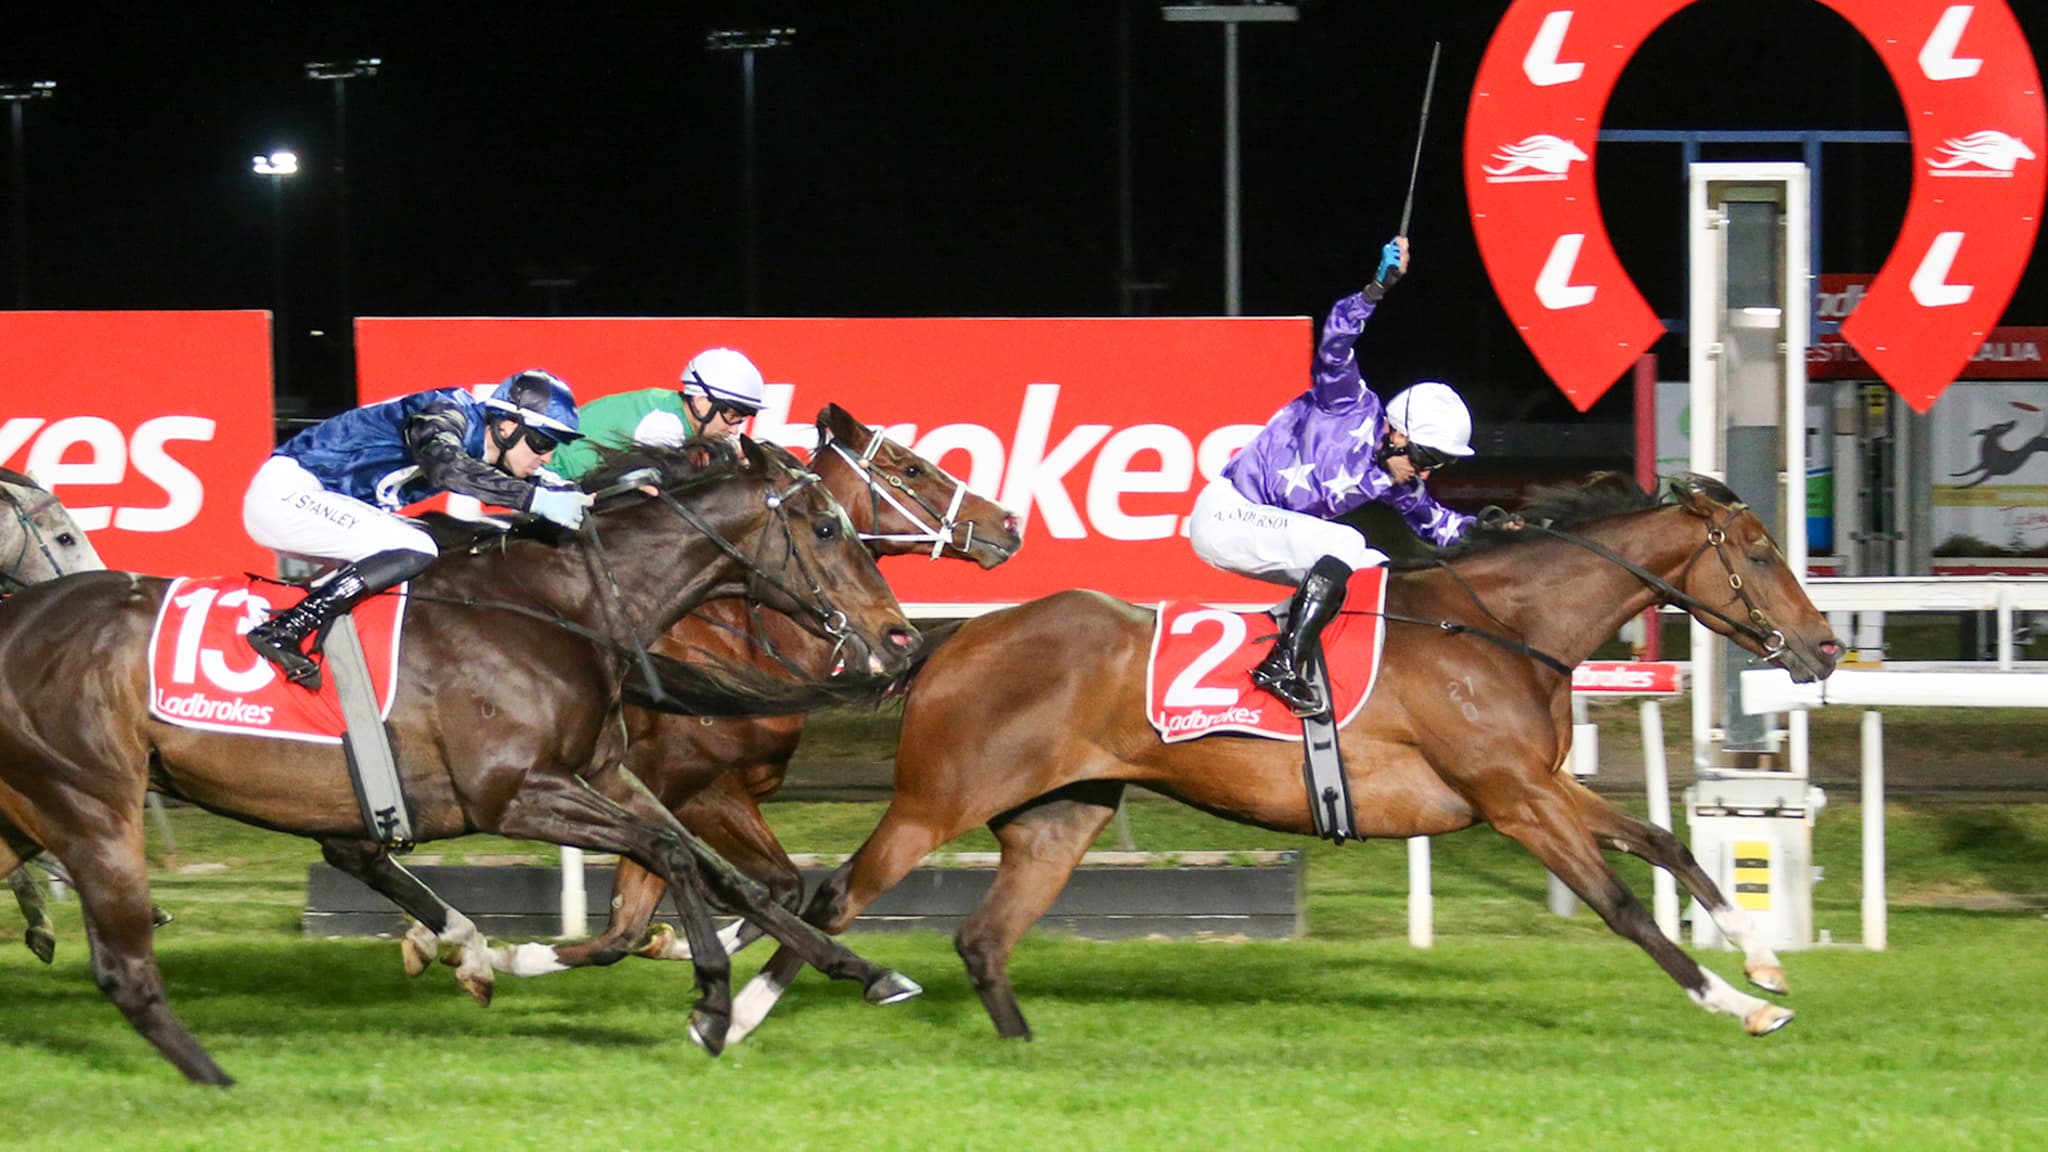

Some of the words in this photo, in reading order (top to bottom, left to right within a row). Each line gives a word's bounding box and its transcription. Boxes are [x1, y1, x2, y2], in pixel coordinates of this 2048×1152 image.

[295, 494, 360, 529] STANLEY
[174, 586, 276, 692] 13
[1164, 609, 1247, 707] 2
[158, 688, 274, 724] Ladbrokes
[1160, 707, 1263, 732] Ladbrokes
